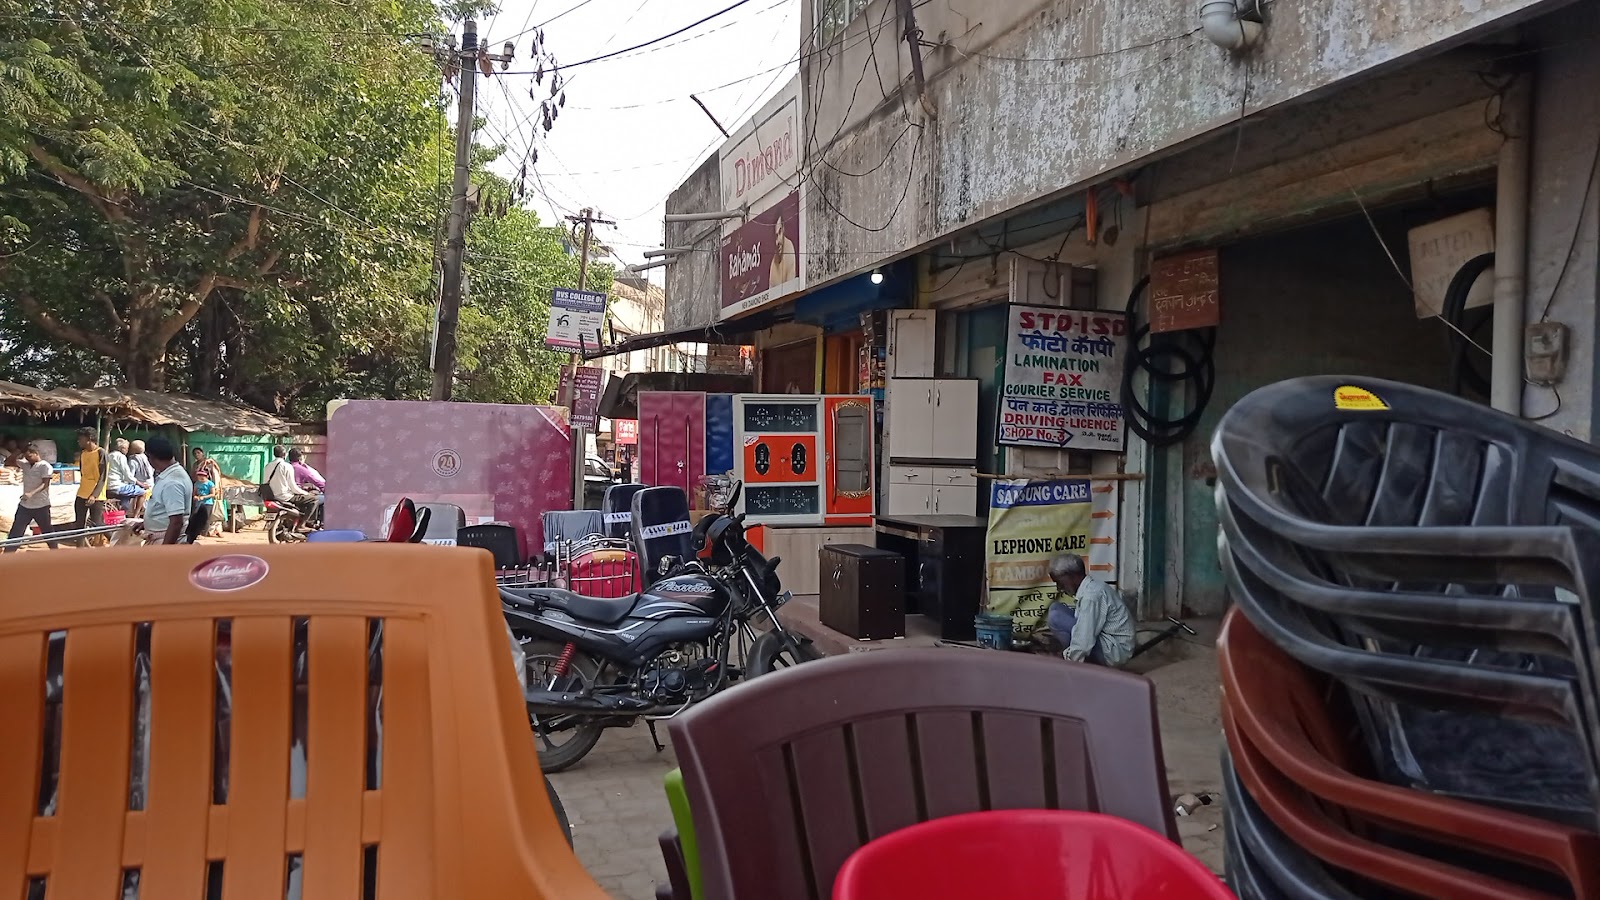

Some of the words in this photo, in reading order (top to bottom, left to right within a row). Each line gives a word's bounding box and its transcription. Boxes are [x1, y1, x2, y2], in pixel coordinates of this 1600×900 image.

[569, 292, 595, 301] COLLEGE
[1018, 330, 1070, 353] फोटो
[1015, 354, 1100, 373] LAMINATION
[1043, 372, 1083, 387] FAX
[1006, 384, 1056, 398] COURIER
[1060, 388, 1111, 401] SERVICE
[1005, 427, 1034, 439] SHOP
[440, 456, 454, 470] 24
[1053, 484, 1088, 501] CARE
[994, 538, 1053, 556] LEPHONE
[1054, 535, 1086, 552] CARE
[621, 632, 635, 640] Hero
